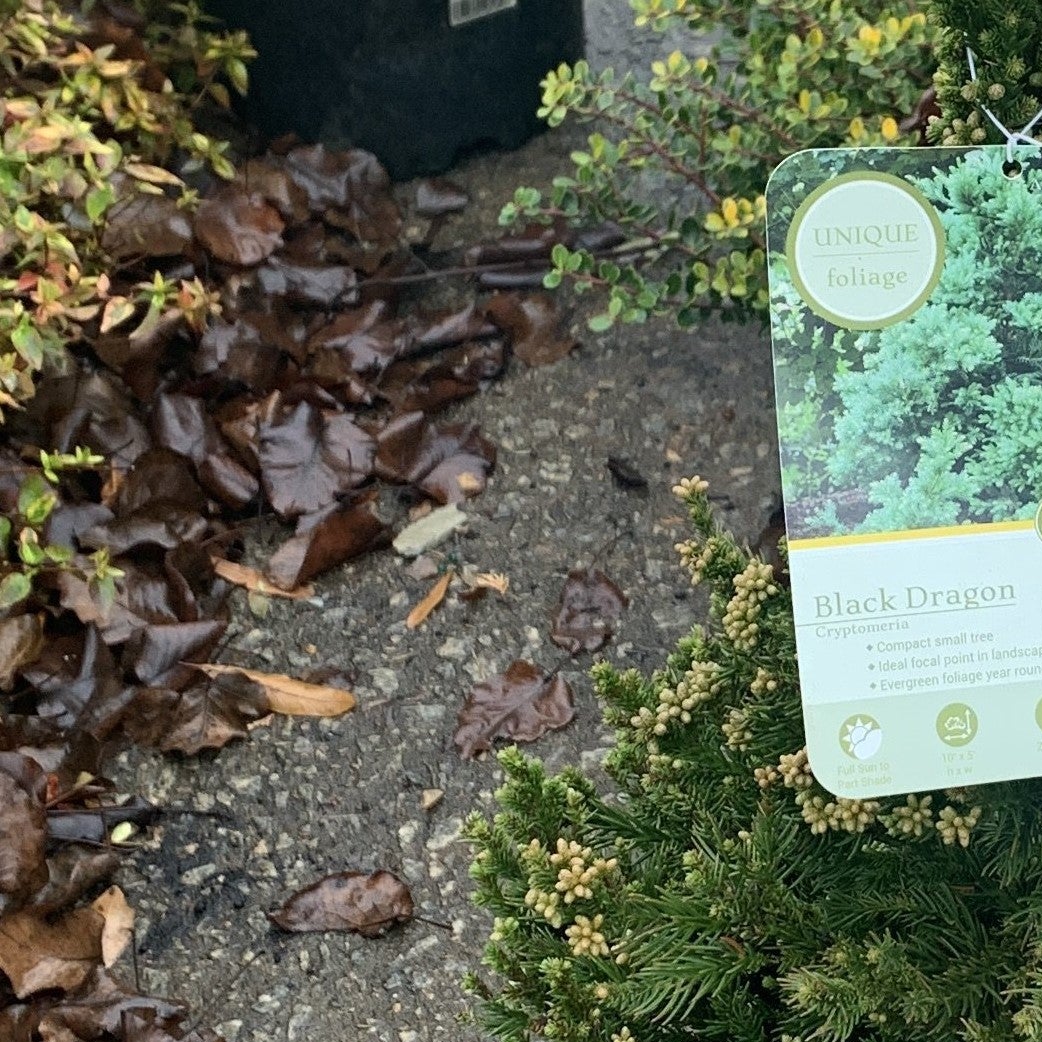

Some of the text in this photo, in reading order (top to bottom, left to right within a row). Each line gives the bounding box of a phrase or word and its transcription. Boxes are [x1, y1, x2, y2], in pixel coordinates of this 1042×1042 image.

[813, 224, 919, 247] UNIQUE
[828, 267, 908, 289] foliage
[814, 584, 1016, 618] Black Dragon
[815, 618, 910, 640] Cryptomeria
[877, 632, 994, 653] Compact small tree
[879, 657, 907, 672] Ideal
[911, 654, 940, 669] focal
[944, 652, 974, 668] point
[977, 650, 988, 661] in
[880, 676, 939, 691] Evergreen
[942, 670, 983, 684] foliage
[985, 668, 1011, 682] year
[837, 762, 890, 776] Full Sun to
[837, 775, 892, 790] Part Shade
